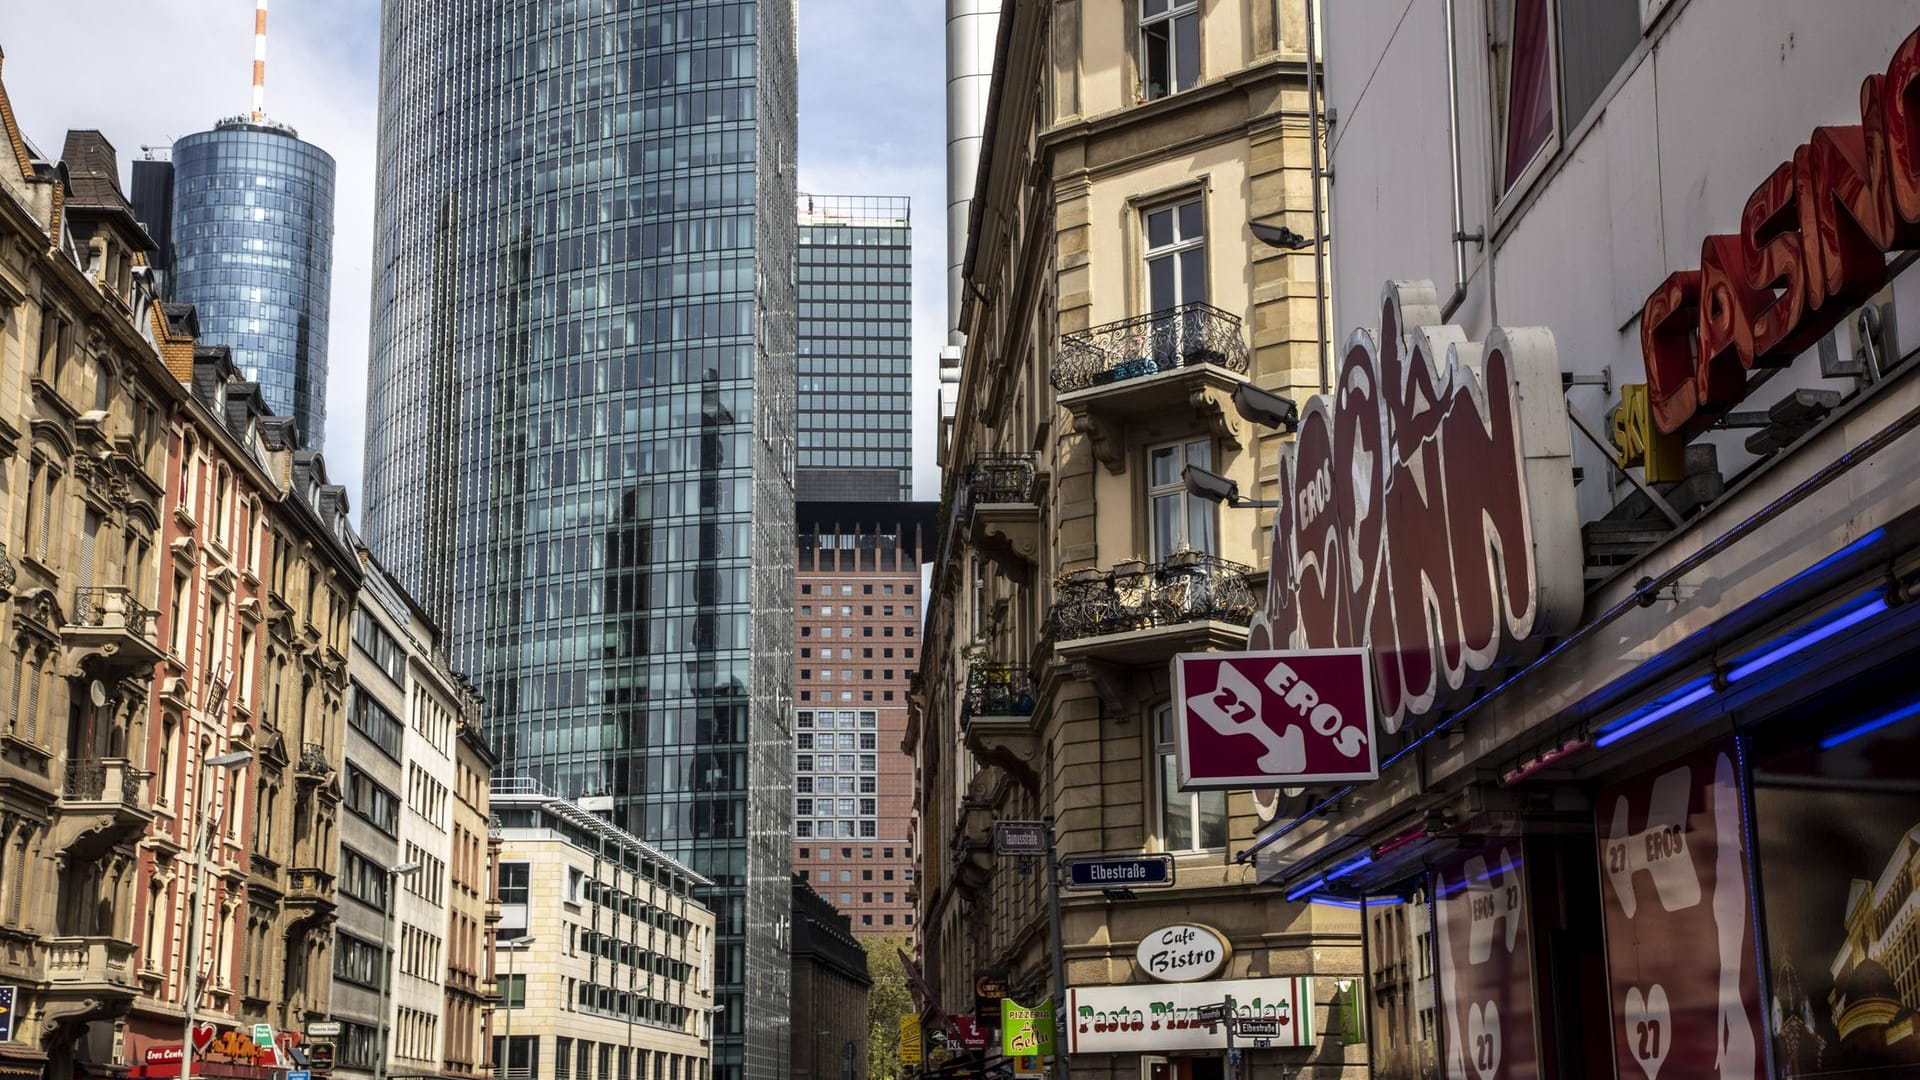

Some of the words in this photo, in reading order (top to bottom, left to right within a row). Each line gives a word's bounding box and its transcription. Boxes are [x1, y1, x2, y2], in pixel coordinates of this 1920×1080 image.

[1300, 461, 1332, 533] EROS
[1212, 686, 1257, 724] 27
[1263, 662, 1368, 758] EROS
[1608, 842, 1627, 875] 27
[1645, 823, 1684, 863] EROS
[1090, 863, 1147, 880] Elbestraße
[1472, 891, 1495, 922] EROS
[1505, 884, 1519, 911] 27
[1162, 928, 1195, 945] Cafe
[1149, 949, 1216, 973] Bistro
[1078, 1005, 1144, 1034] Pasta
[1242, 1023, 1275, 1034] Elbestraße
[147, 1050, 162, 1060] Eros
[1476, 1033, 1494, 1072] 27
[1636, 1020, 1661, 1061] 27
